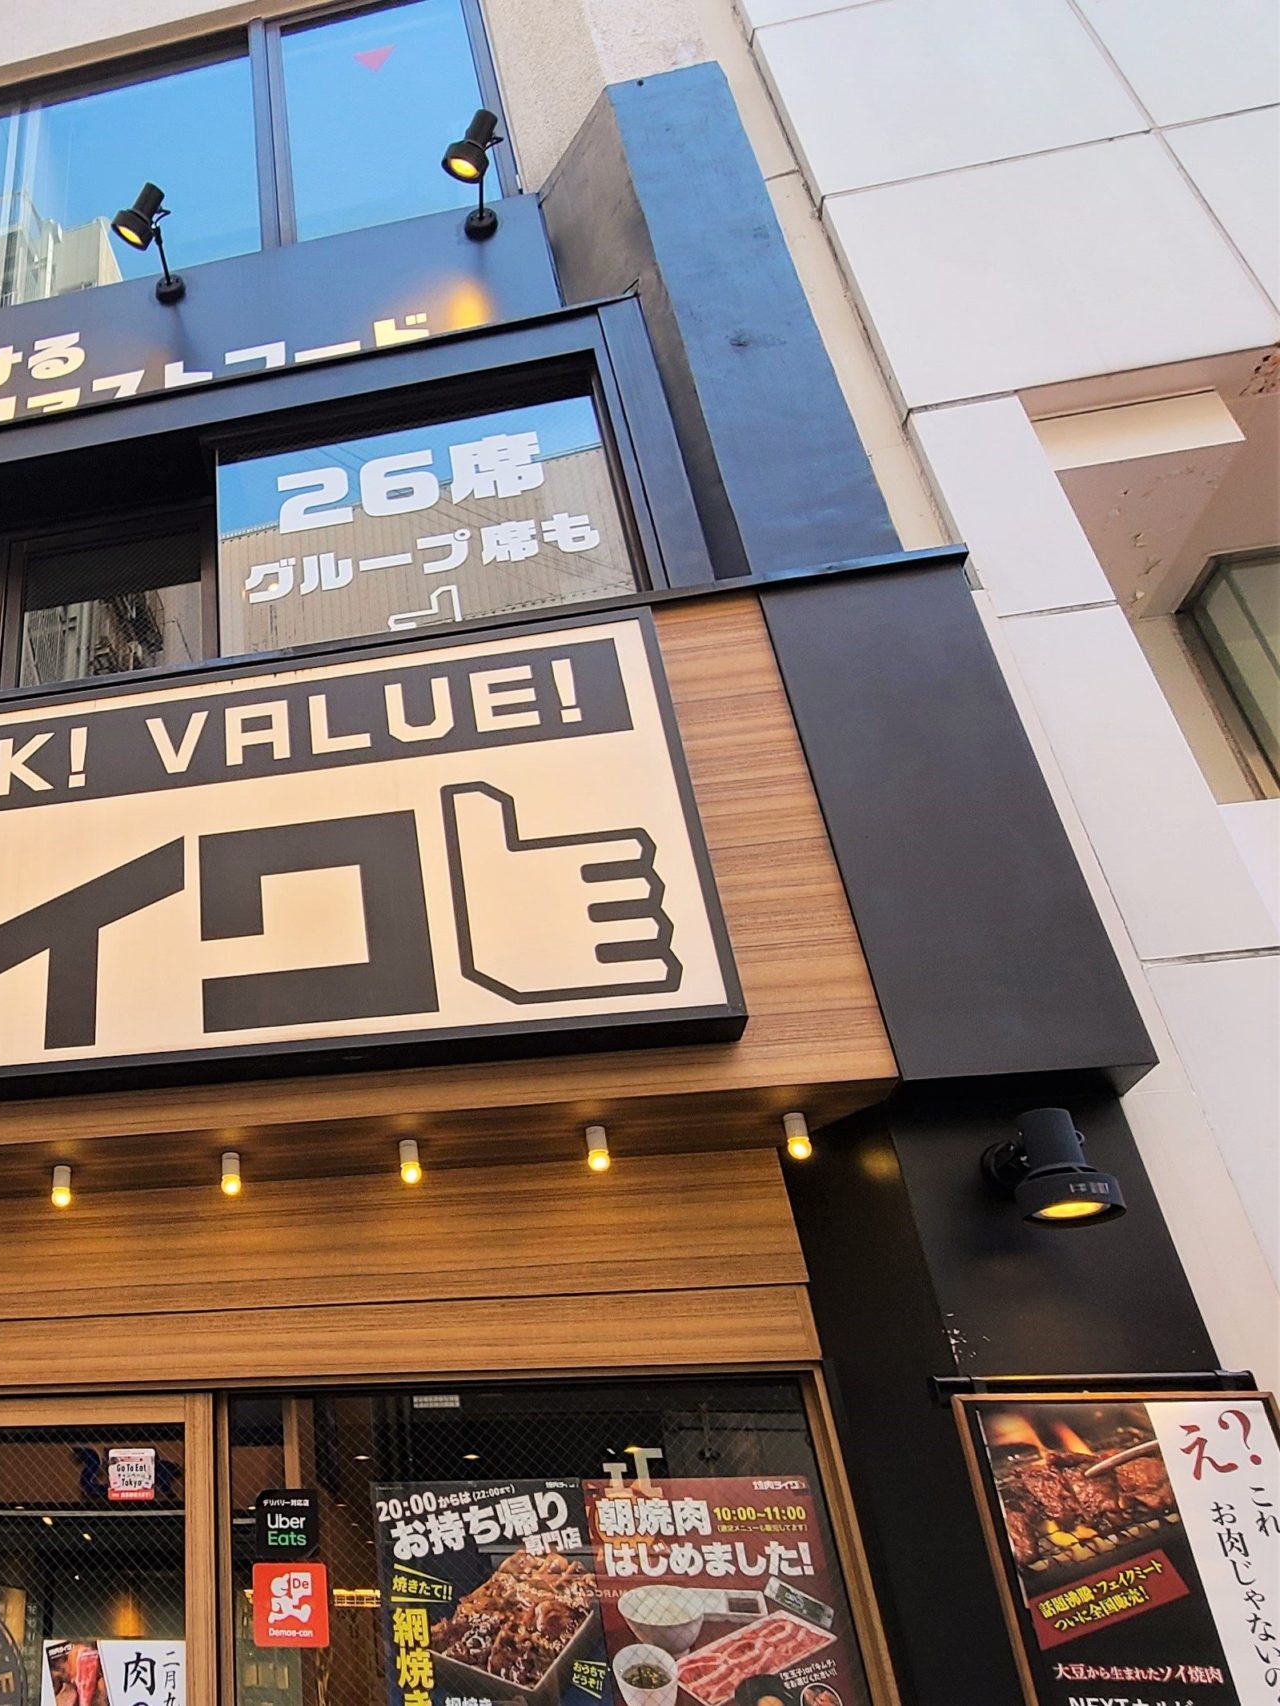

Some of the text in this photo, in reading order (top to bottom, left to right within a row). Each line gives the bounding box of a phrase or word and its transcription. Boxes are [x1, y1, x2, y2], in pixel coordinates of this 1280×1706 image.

[277, 431, 545, 534] 26席
[244, 512, 600, 604] グループ席も
[146, 658, 584, 774] VALUE!
[267, 1513, 306, 1529] Uber
[376, 1491, 470, 1522] 20:00からは
[596, 1497, 712, 1537] 朝焼肉
[268, 1531, 307, 1546] Eats
[390, 1492, 569, 1560] お持ち帰り
[522, 1527, 582, 1556] 専門店
[604, 1540, 815, 1577] はじめました!
[292, 1578, 309, 1589] De
[392, 1575, 453, 1601] 焼きたて!!
[1054, 1585, 1150, 1631] ついに全国販売!
[268, 1627, 313, 1638] Demae-can
[1053, 1663, 1224, 1684] 大豆から生まれたソイ焼肉
